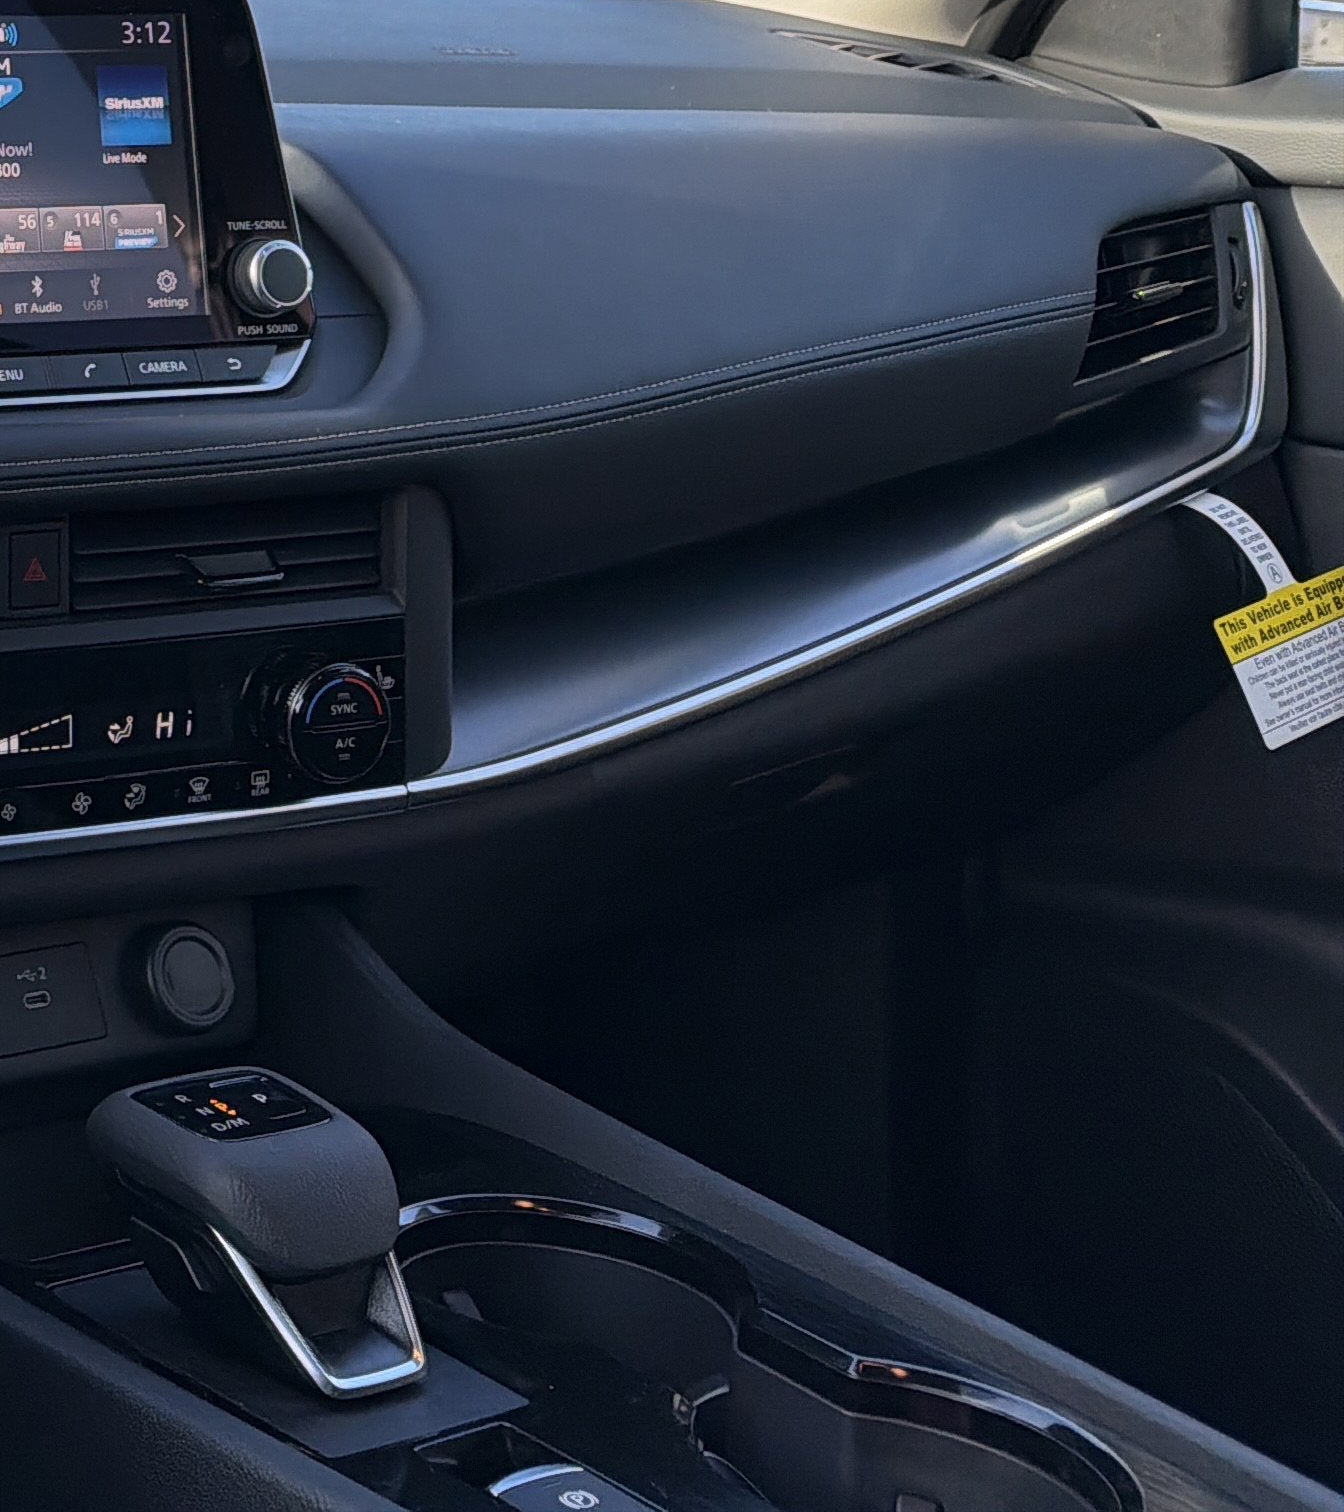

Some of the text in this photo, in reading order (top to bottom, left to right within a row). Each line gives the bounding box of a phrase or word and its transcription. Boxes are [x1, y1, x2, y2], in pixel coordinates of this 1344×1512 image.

[121, 21, 172, 44] 3:12
[103, 152, 148, 165] Live Mode
[18, 214, 36, 230] 56
[74, 212, 101, 228] 114
[156, 210, 163, 225] 1
[15, 301, 62, 315] BT Audio
[83, 299, 109, 311] USB1
[147, 296, 189, 310] Settings
[238, 323, 298, 336] PUSH SOUND
[138, 361, 188, 375] CAMERA
[1219, 576, 1344, 637] This Vehicle is Equipp
[1230, 596, 1344, 656] with Advanced Air B
[330, 702, 358, 715] SYNC
[155, 710, 192, 739] Hi
[336, 738, 356, 749] A/C
[174, 1094, 192, 1104] R
[251, 1093, 268, 1104] P
[195, 1106, 216, 1116] N
[211, 1117, 250, 1132] D/M
